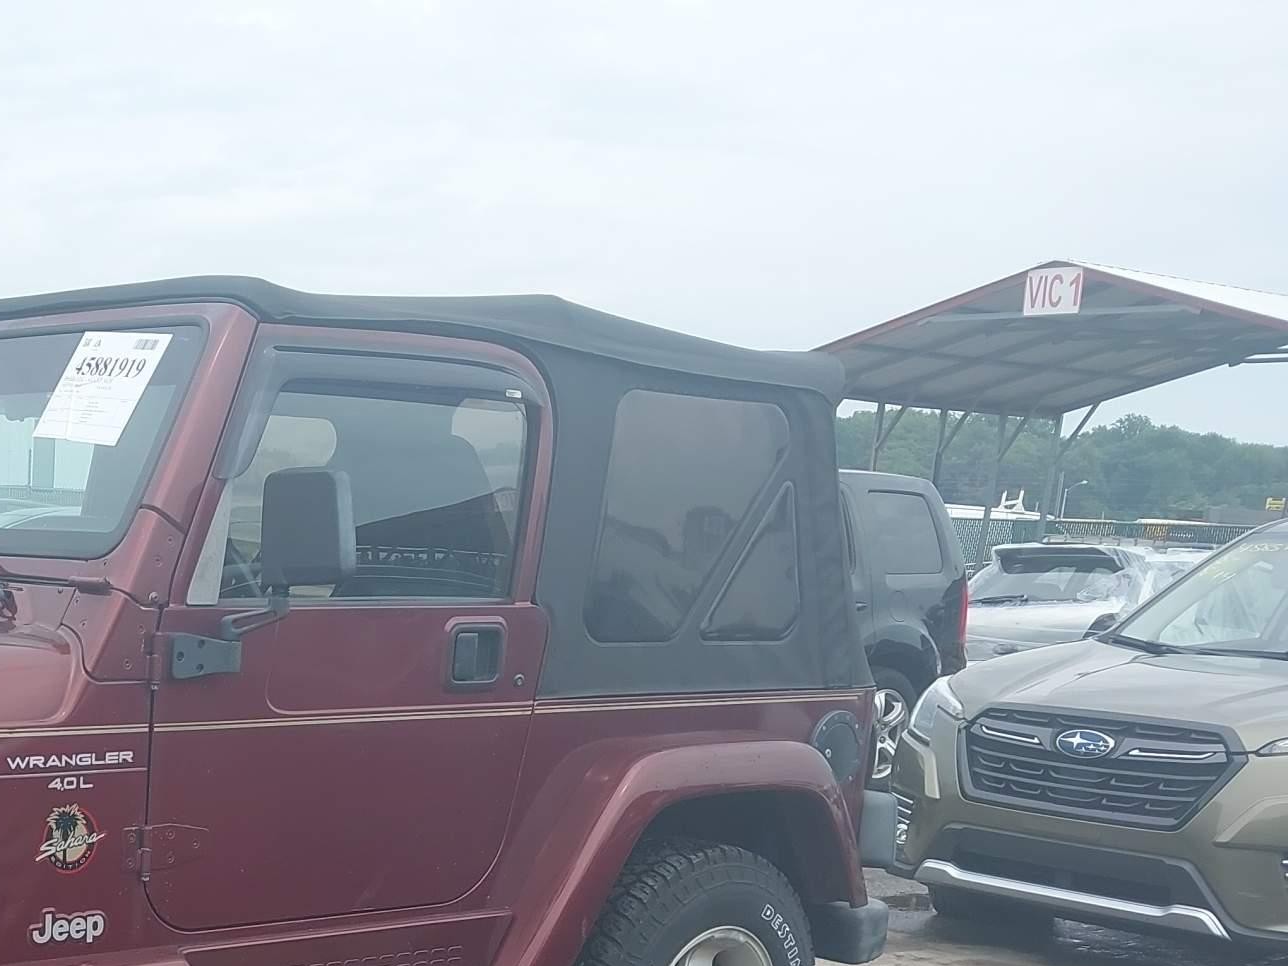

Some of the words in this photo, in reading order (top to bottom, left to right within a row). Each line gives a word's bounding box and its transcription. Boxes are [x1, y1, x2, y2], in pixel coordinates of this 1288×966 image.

[1028, 273, 1063, 309] VIC
[1069, 271, 1082, 307] 1
[75, 356, 147, 378] 45881919
[6, 750, 134, 769] WRANGLER
[35, 831, 107, 862] Sahara
[30, 911, 105, 944] Jeep
